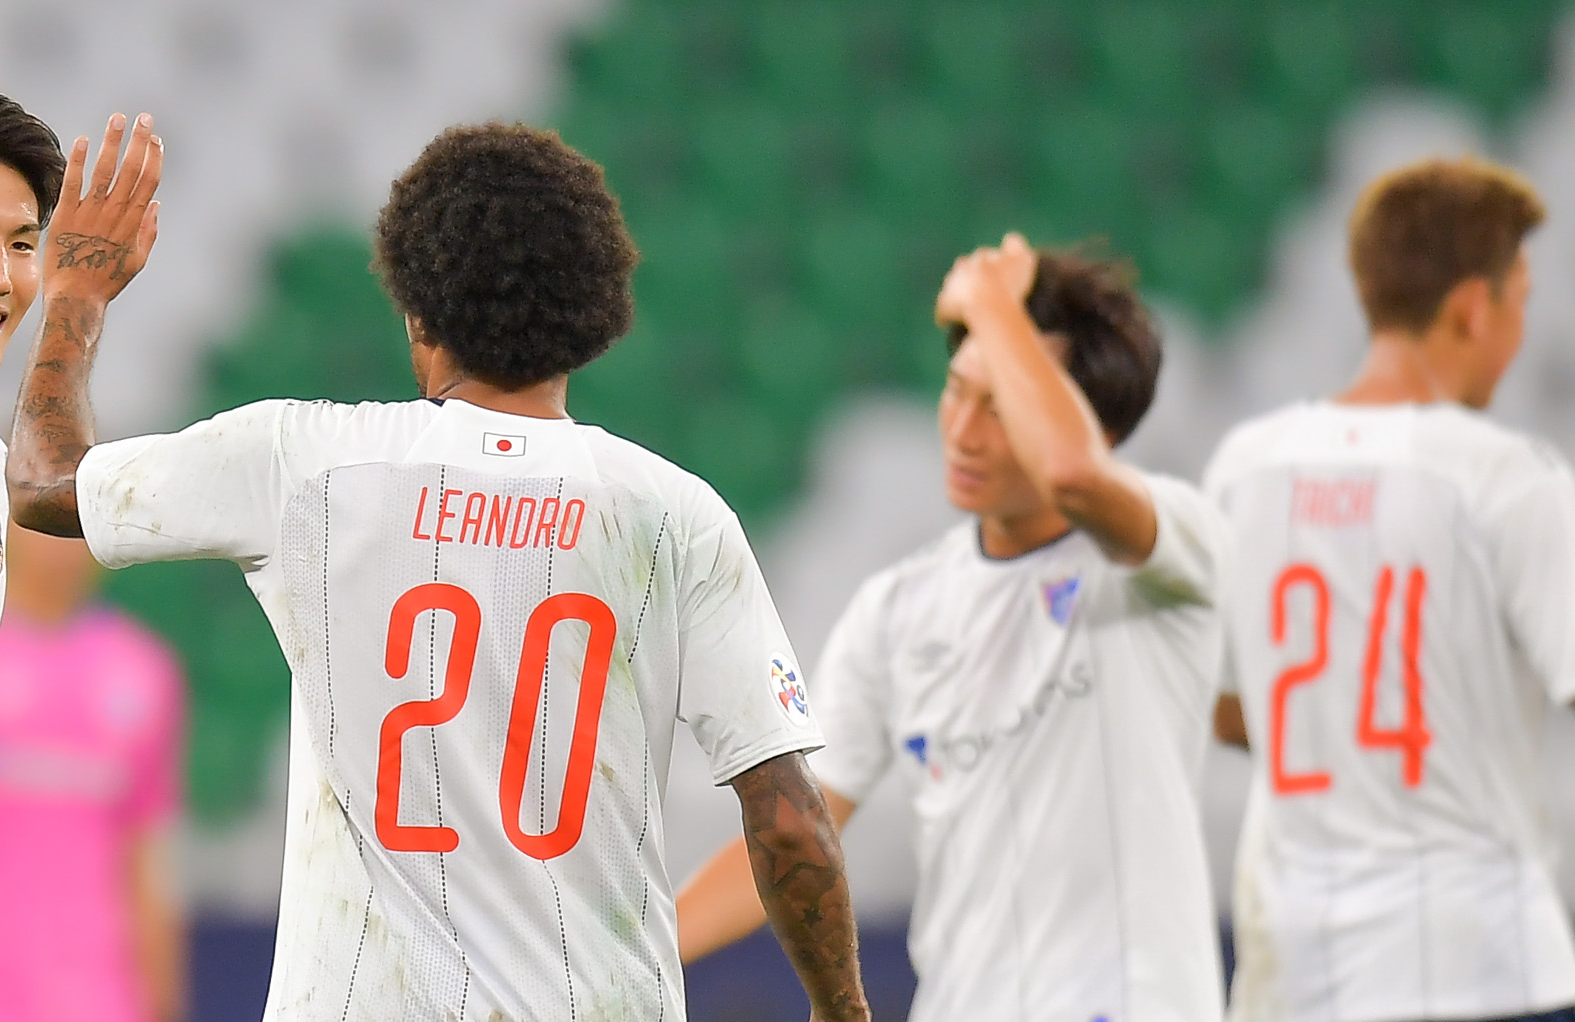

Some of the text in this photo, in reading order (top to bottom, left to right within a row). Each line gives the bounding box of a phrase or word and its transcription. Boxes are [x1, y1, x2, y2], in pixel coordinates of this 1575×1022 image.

[413, 487, 585, 550] LEANDRO
[375, 583, 617, 861] 20
[1268, 562, 1434, 798] 24
